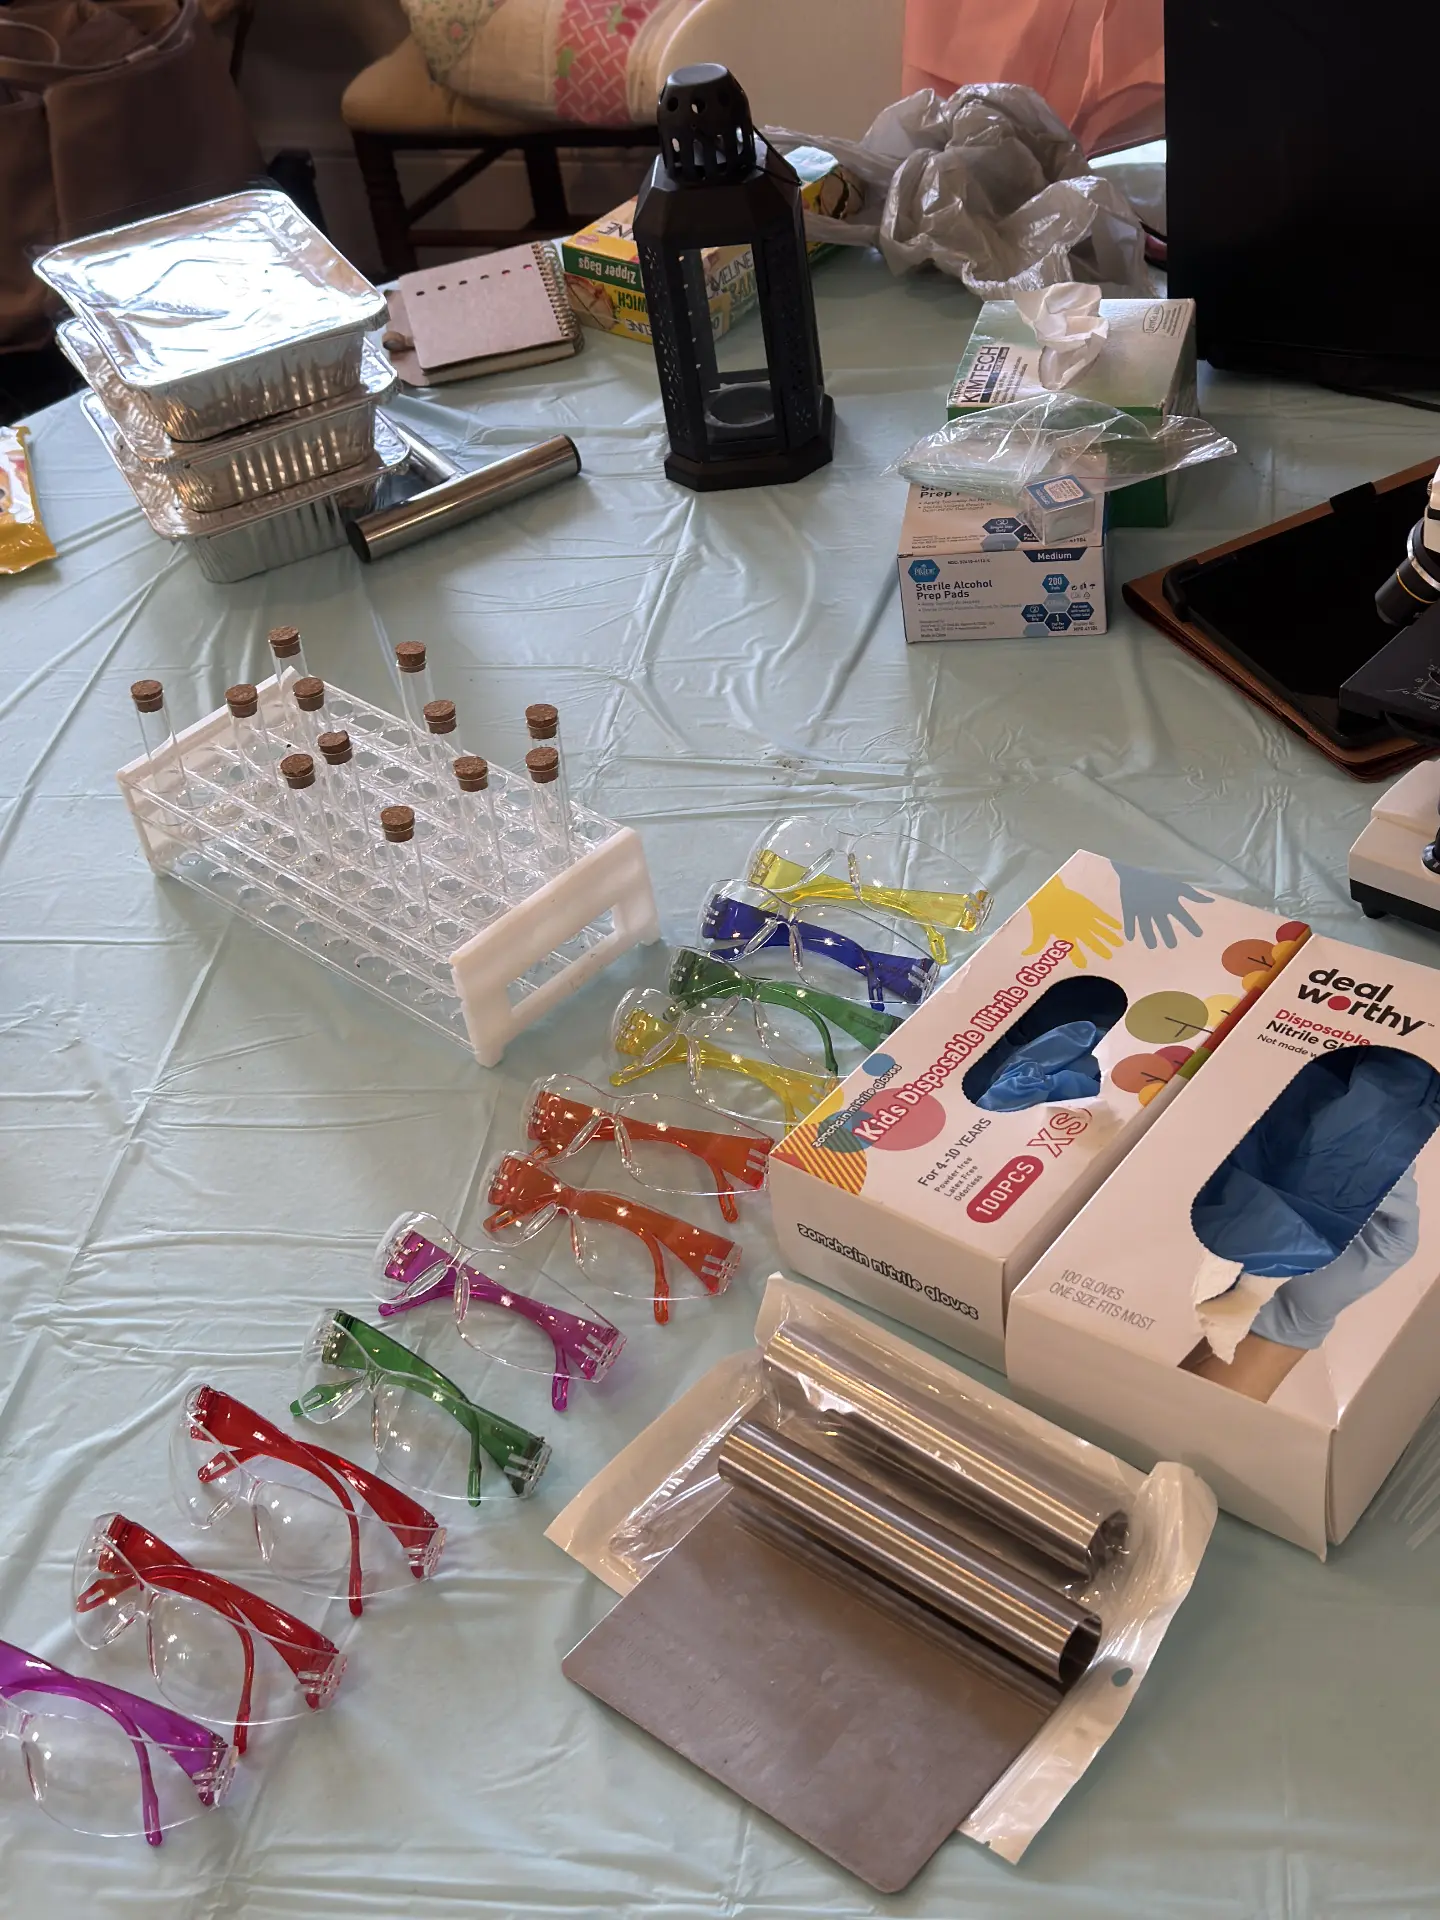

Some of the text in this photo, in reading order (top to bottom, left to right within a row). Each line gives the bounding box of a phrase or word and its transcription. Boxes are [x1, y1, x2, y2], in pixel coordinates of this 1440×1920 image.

[578, 256, 637, 284] Zipper Bags
[961, 346, 1000, 403] KIMTECH
[920, 491, 952, 499] Prep
[1037, 552, 1072, 561] Medium
[915, 579, 993, 592] Sterile Alcohol
[916, 589, 970, 601] Prep Pads
[1048, 577, 1063, 586] 200
[1308, 968, 1394, 1003] deal
[852, 939, 1074, 1142] Kids Disposable Nitrile Gloves
[1265, 1019, 1319, 1045] Nitrile
[1275, 1009, 1371, 1046] Disposable
[1257, 1033, 1276, 1045] Not
[1278, 1040, 1309, 1056] made
[812, 1063, 902, 1148] zomchain nitrile gloves
[1027, 1108, 1093, 1158] XS
[917, 1117, 992, 1187] For 4-10 YEARS
[934, 1165, 958, 1192] Powder
[944, 1165, 978, 1198] Latex Free
[954, 1174, 983, 1202] Odorless
[976, 1161, 1035, 1216] 100PCS
[797, 1223, 979, 1320] zomchain nitrile gloves
[1061, 1269, 1125, 1300] 100 GLOVES
[1049, 1282, 1157, 1331] ONE SIZE FITS MOST
